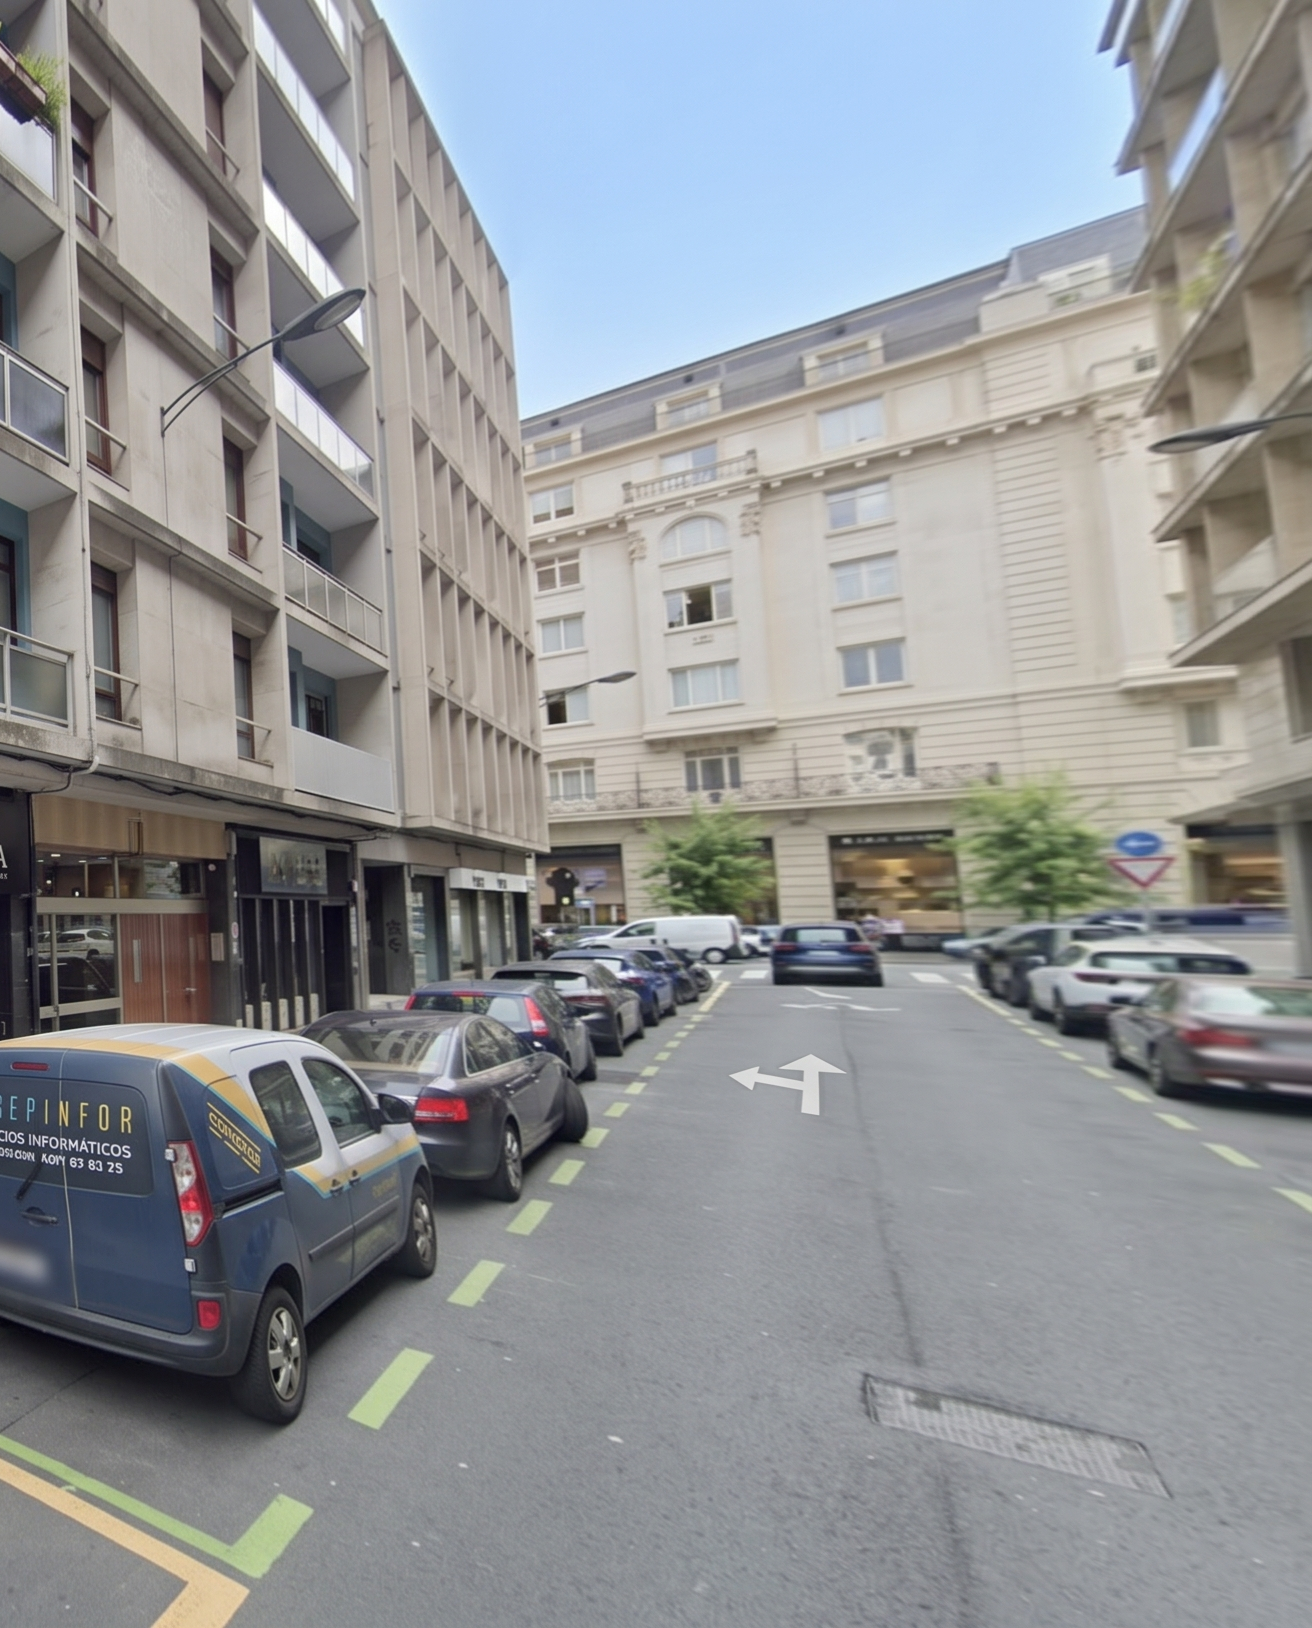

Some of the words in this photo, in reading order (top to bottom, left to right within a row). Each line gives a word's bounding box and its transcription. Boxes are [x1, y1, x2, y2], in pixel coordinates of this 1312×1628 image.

[28, 1133, 132, 1159] INFORMÁTICOS
[69, 1157, 84, 1169] 63
[107, 1162, 123, 1174] 25
